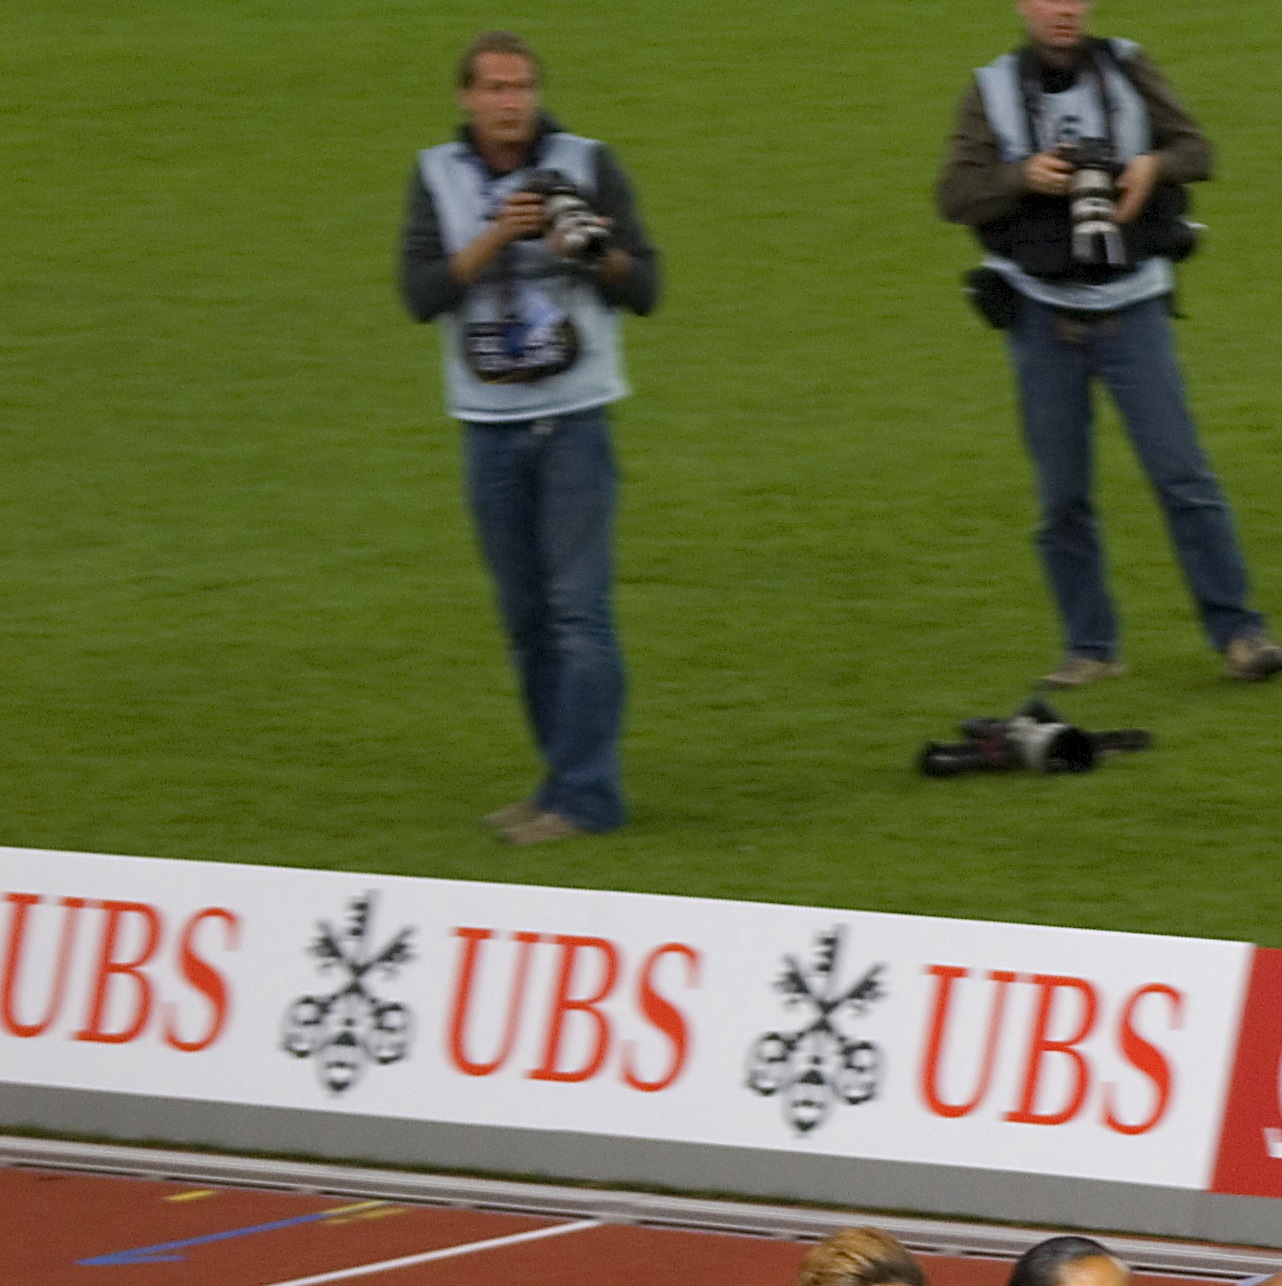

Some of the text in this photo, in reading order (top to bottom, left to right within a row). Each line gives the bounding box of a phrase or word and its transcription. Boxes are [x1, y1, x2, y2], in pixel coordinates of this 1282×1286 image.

[2, 892, 241, 1052] UBS
[446, 926, 702, 1093] UBS
[919, 964, 1183, 1137] UBS
